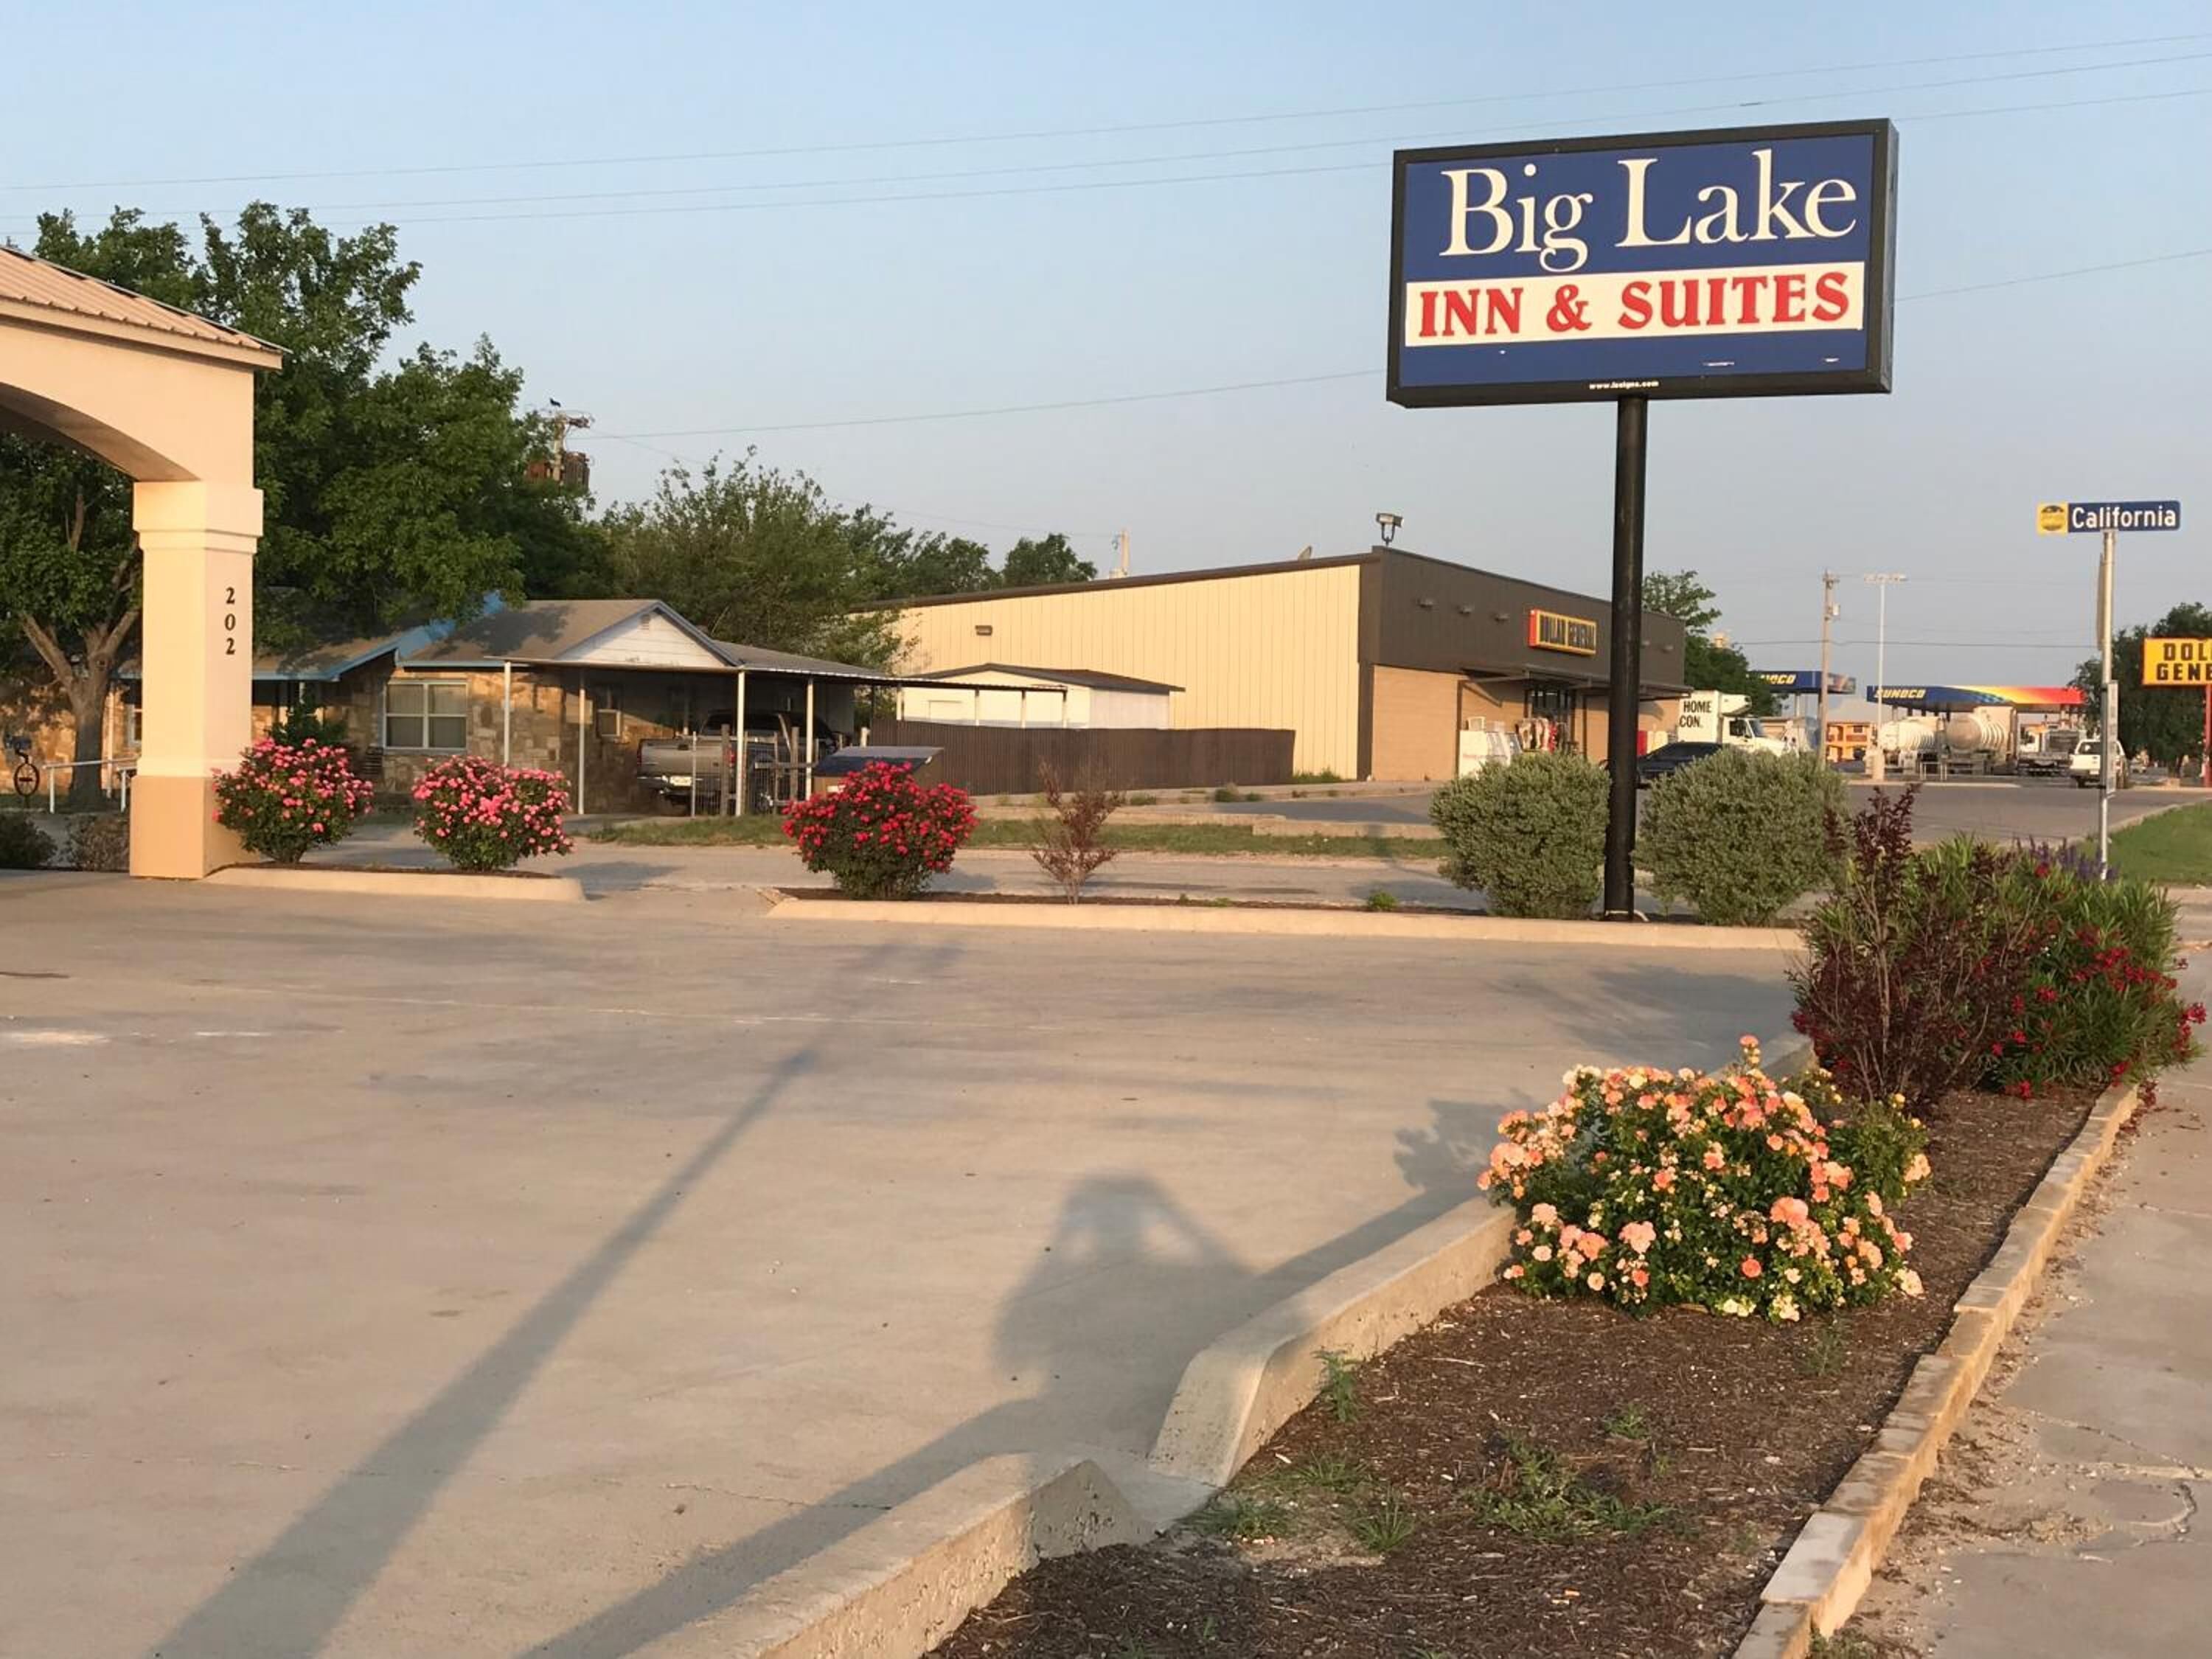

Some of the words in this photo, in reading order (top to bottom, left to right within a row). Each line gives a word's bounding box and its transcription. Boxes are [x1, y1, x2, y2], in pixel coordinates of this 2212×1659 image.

[1439, 163, 1593, 272] Big
[1615, 148, 1857, 247] Lake
[1418, 288, 1523, 338] INN
[1547, 284, 1592, 333] &
[1618, 272, 1848, 330] SUITES
[2072, 505, 2176, 528] California
[225, 587, 235, 655] 202
[2163, 643, 2212, 661] DOL
[1874, 689, 1926, 698] SUNOCO
[1683, 700, 1712, 713] HOME
